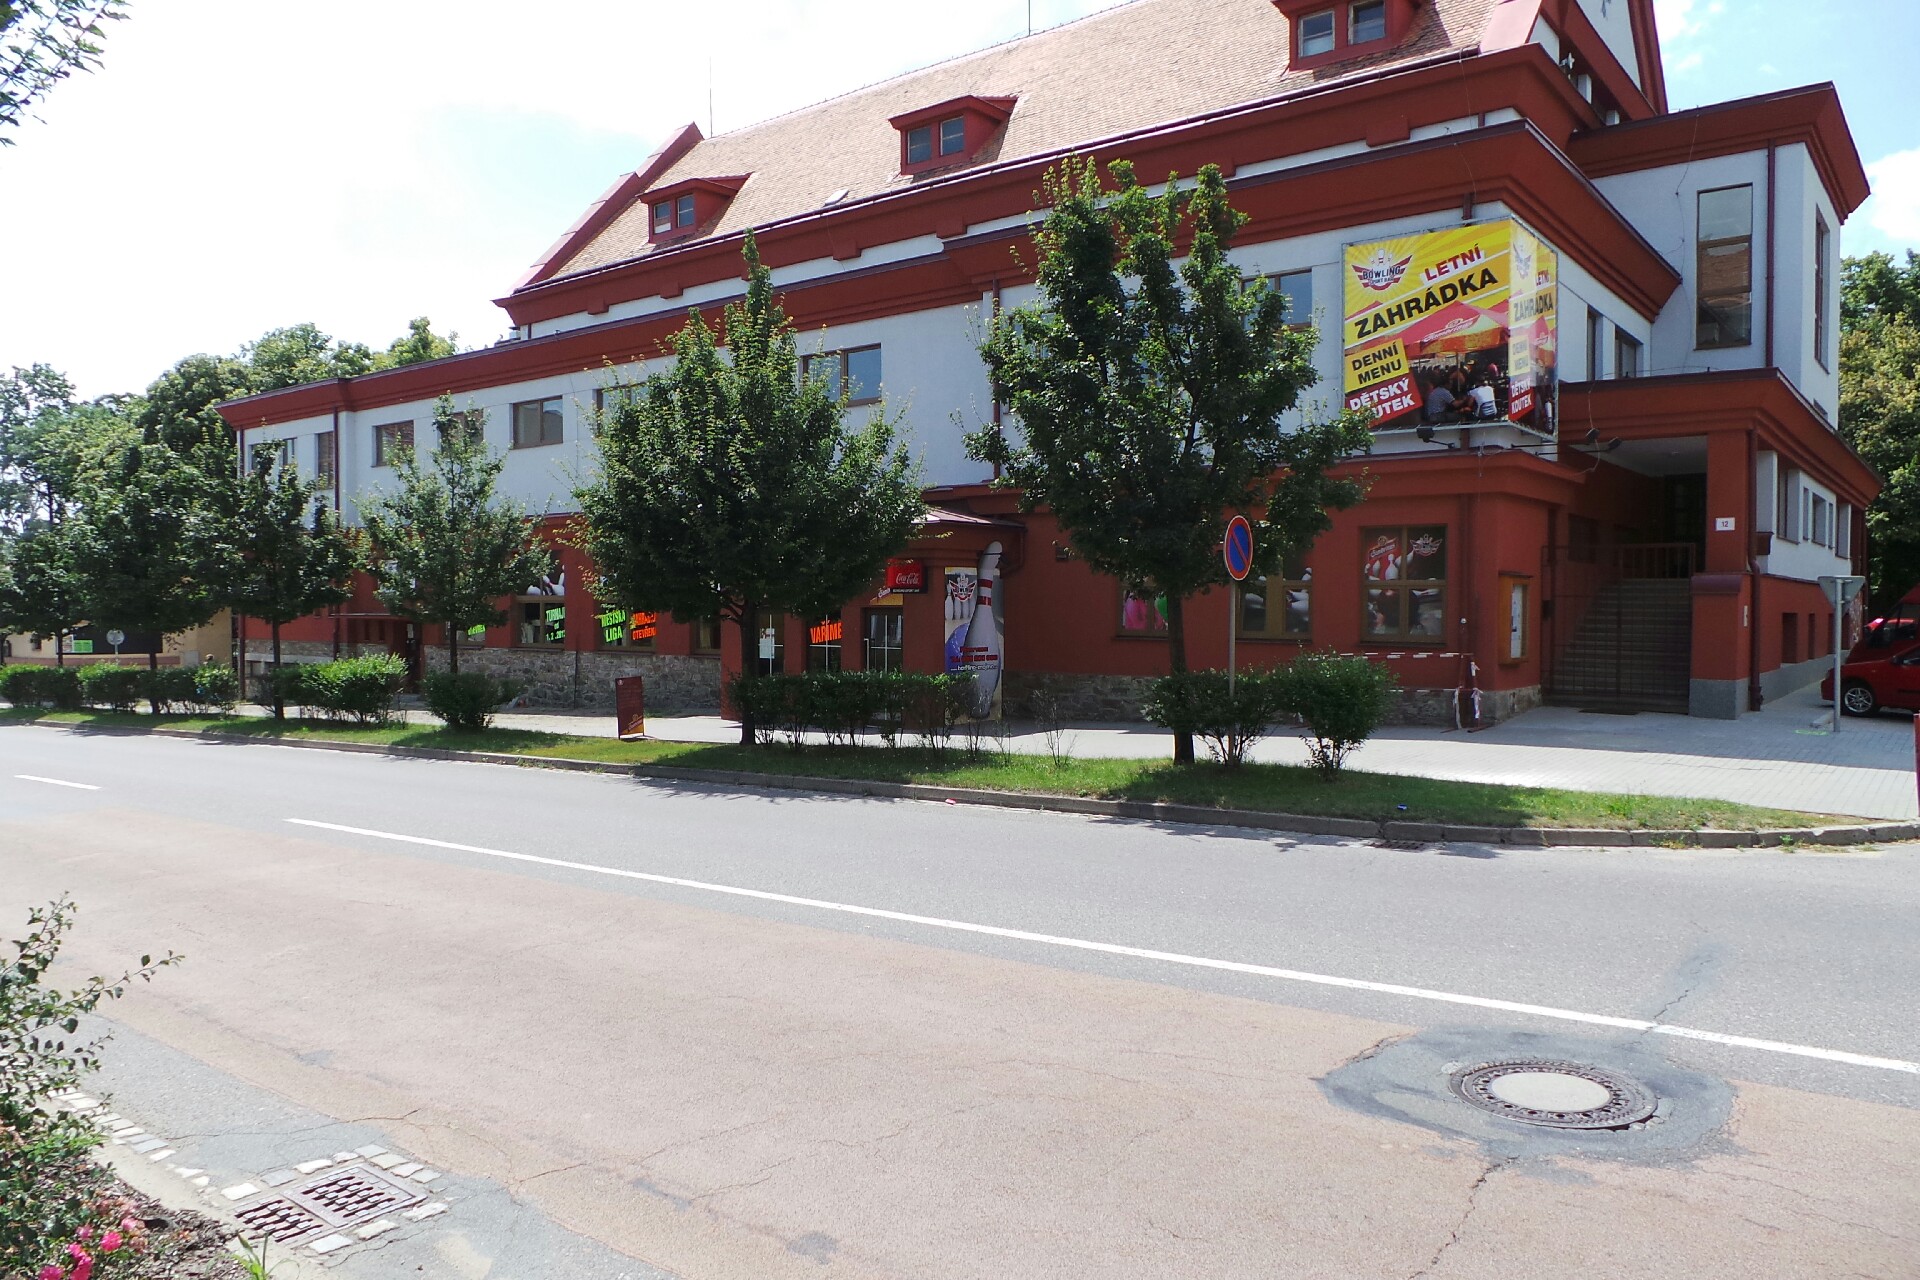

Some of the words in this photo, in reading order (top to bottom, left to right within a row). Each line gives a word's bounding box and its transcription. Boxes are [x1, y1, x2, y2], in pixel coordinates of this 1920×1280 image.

[1362, 265, 1401, 280] BOWLING
[1424, 243, 1483, 281] LETNÍ
[1354, 267, 1498, 339] ZAHRÁDKA
[1352, 341, 1399, 371] DENNÍ
[1358, 359, 1402, 385] MENU
[1349, 377, 1410, 411] DĚTSKÝ
[1371, 393, 1416, 418] UTEK
[1511, 393, 1532, 415] KOUTEK
[1721, 520, 1729, 528] 12
[605, 625, 623, 643] LIGA
[810, 619, 843, 644] VAŘÍME
